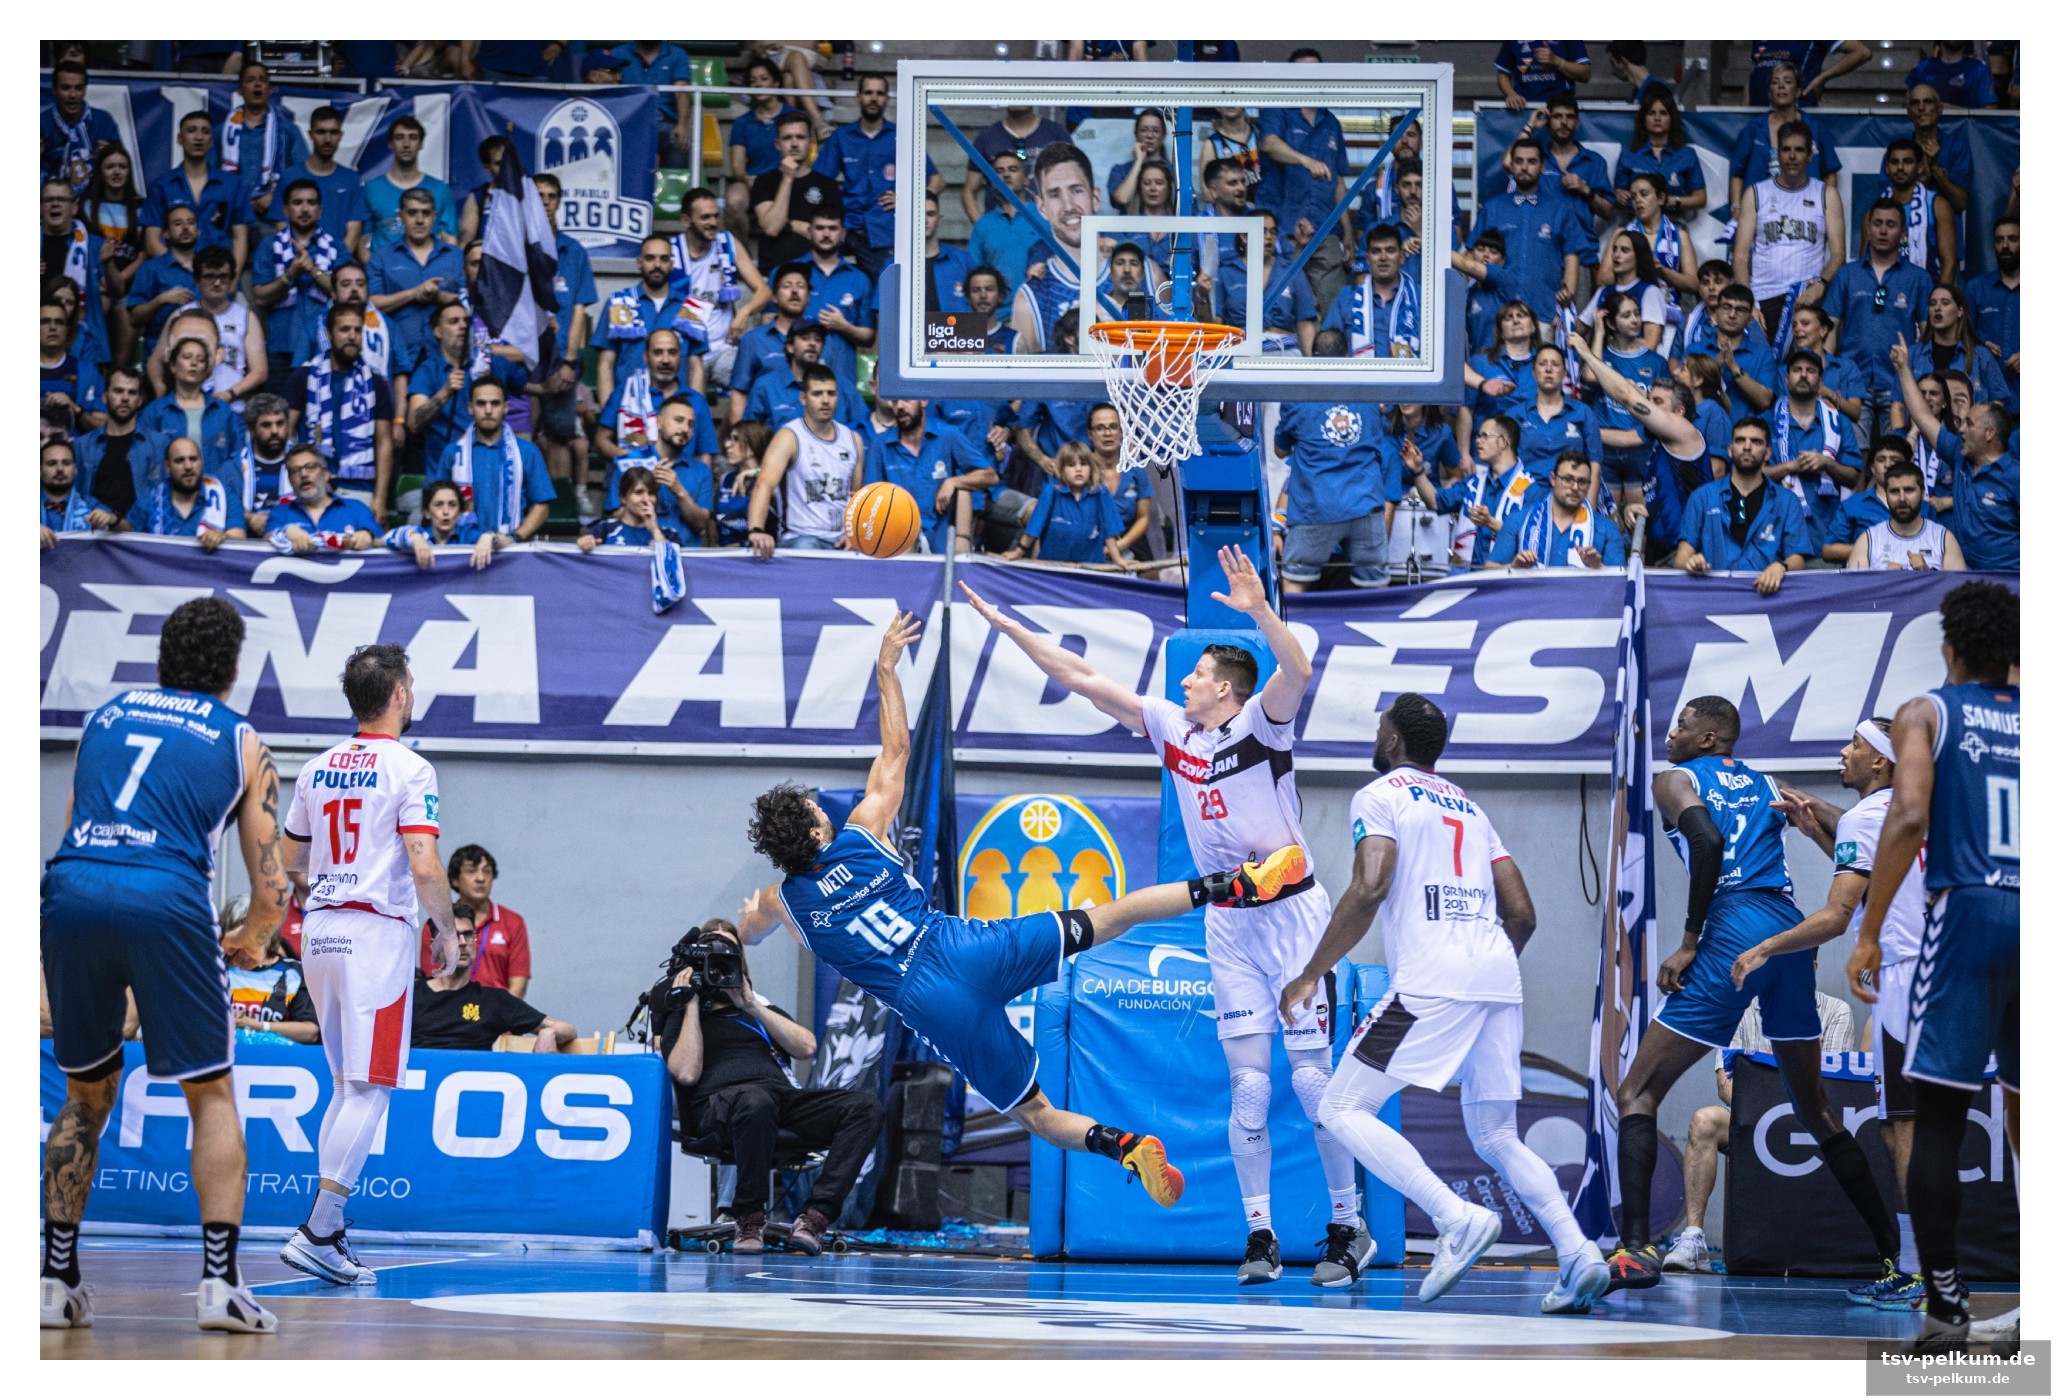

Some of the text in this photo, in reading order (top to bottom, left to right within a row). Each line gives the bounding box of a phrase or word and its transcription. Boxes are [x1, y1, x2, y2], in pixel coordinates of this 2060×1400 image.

[563, 201, 643, 235] RGOS
[928, 323, 954, 338] liga
[928, 336, 985, 349] endesa
[40, 557, 540, 724] EÑA
[114, 733, 164, 812] 7
[328, 752, 379, 770] COSTA
[312, 769, 379, 789] PULEVA
[1198, 788, 1229, 820] 29
[1408, 785, 1477, 817] PULEVA
[322, 798, 363, 865] 15
[1442, 815, 1464, 877] 7
[816, 863, 854, 897] NETO
[869, 867, 890, 889] salud
[845, 898, 917, 956] 19
[311, 934, 352, 948] Diputación
[312, 944, 353, 956] de Granada
[1118, 997, 1191, 1011] FUNDACIÓN
[1284, 1028, 1317, 1036] BERNER
